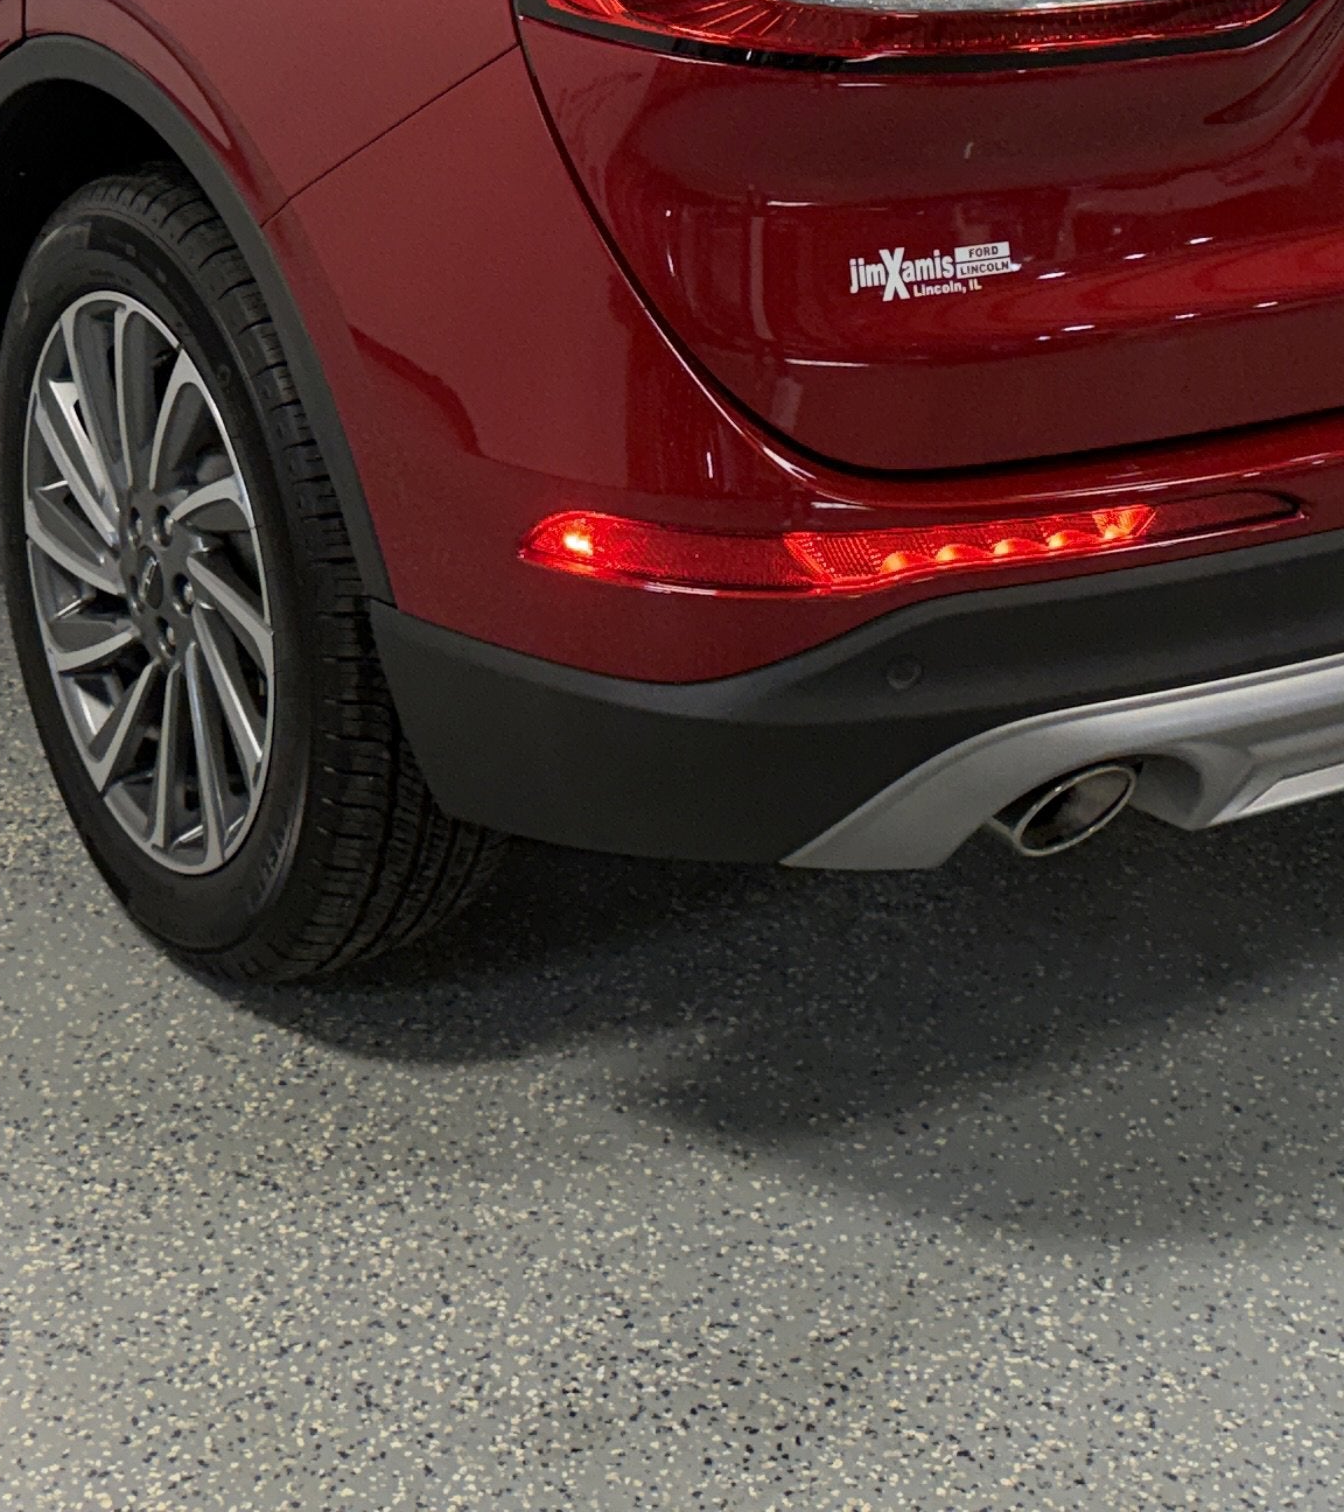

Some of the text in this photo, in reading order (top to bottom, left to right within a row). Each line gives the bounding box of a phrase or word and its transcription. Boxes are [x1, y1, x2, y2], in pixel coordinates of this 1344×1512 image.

[968, 245, 999, 258] FORD
[959, 260, 1010, 276] LINCOLN
[913, 279, 983, 297] Lincoln, IL
